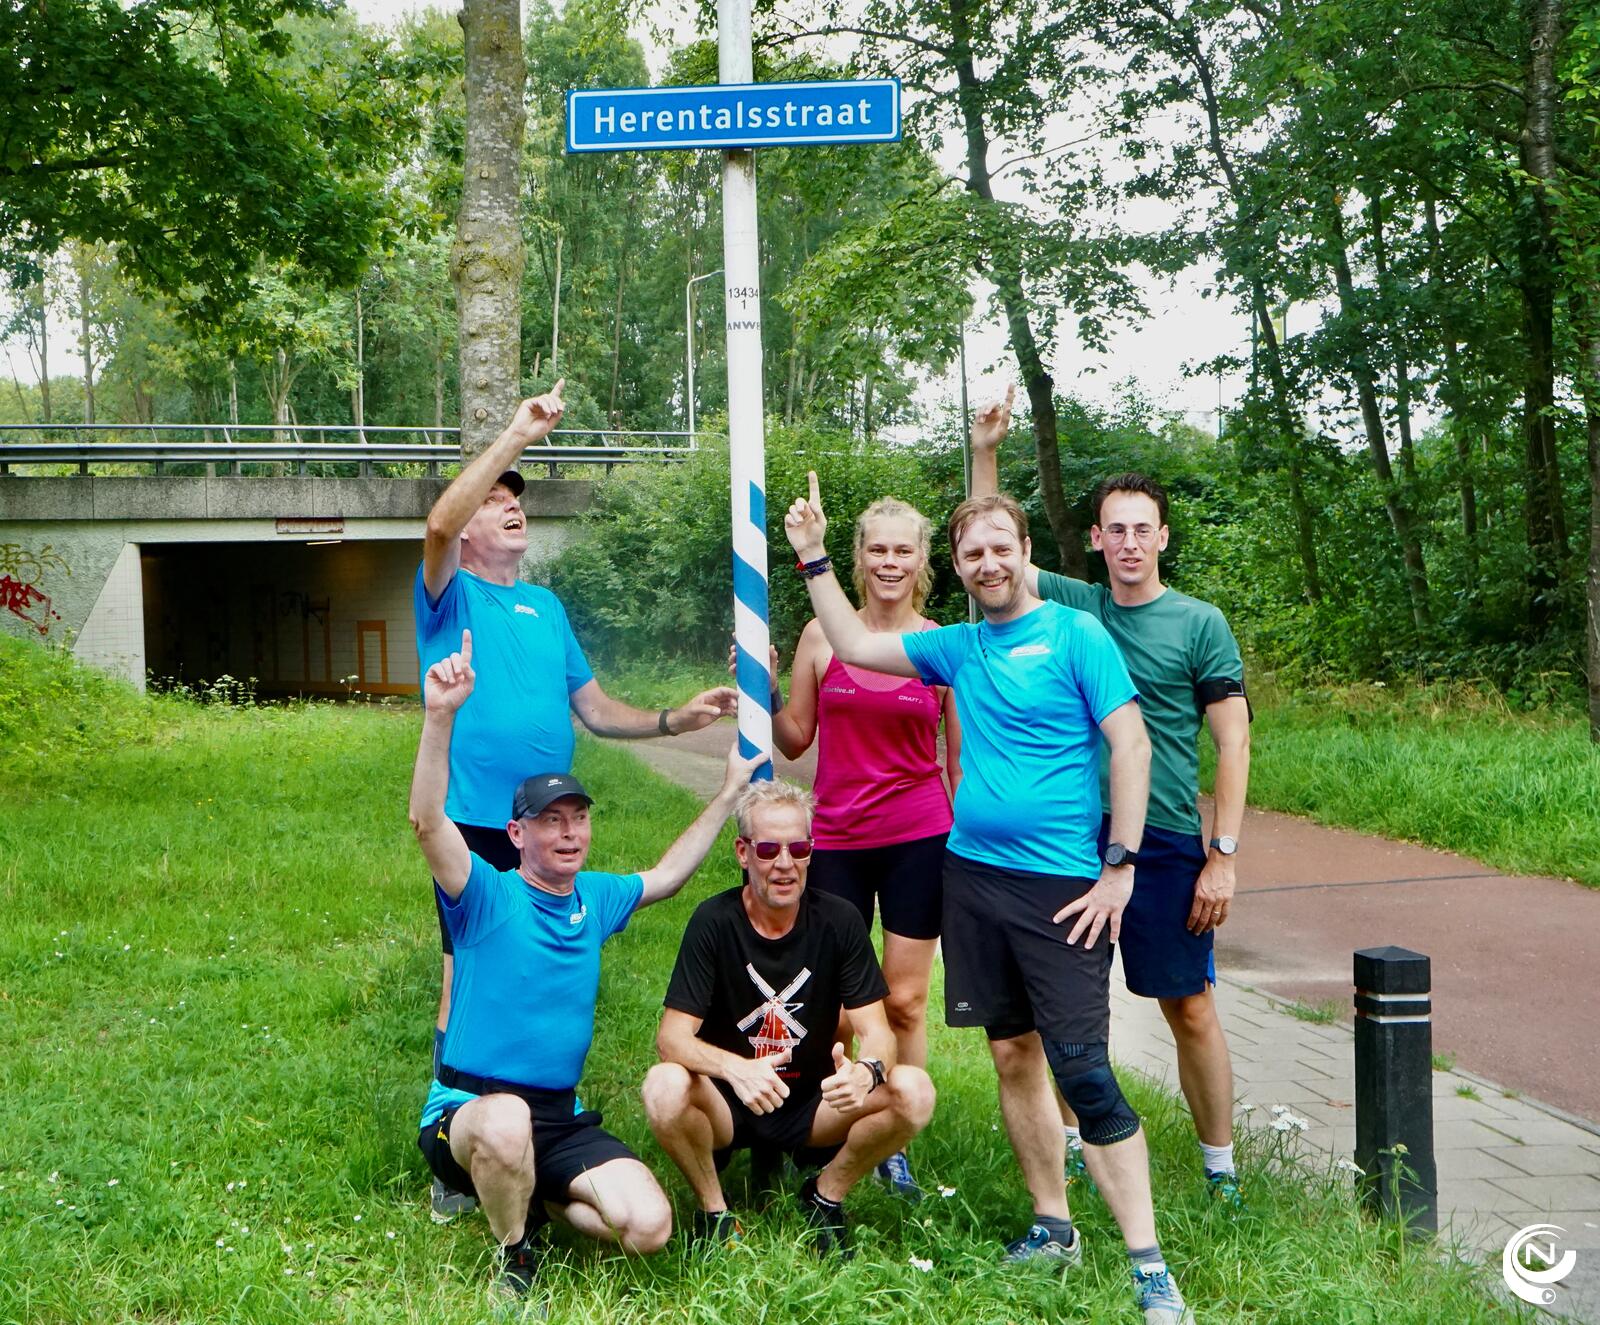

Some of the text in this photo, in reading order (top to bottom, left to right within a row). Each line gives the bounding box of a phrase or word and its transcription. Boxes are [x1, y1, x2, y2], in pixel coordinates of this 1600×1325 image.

[594, 98, 872, 134] Herentalsstraat
[728, 287, 759, 299] 13434
[741, 299, 746, 310] 1
